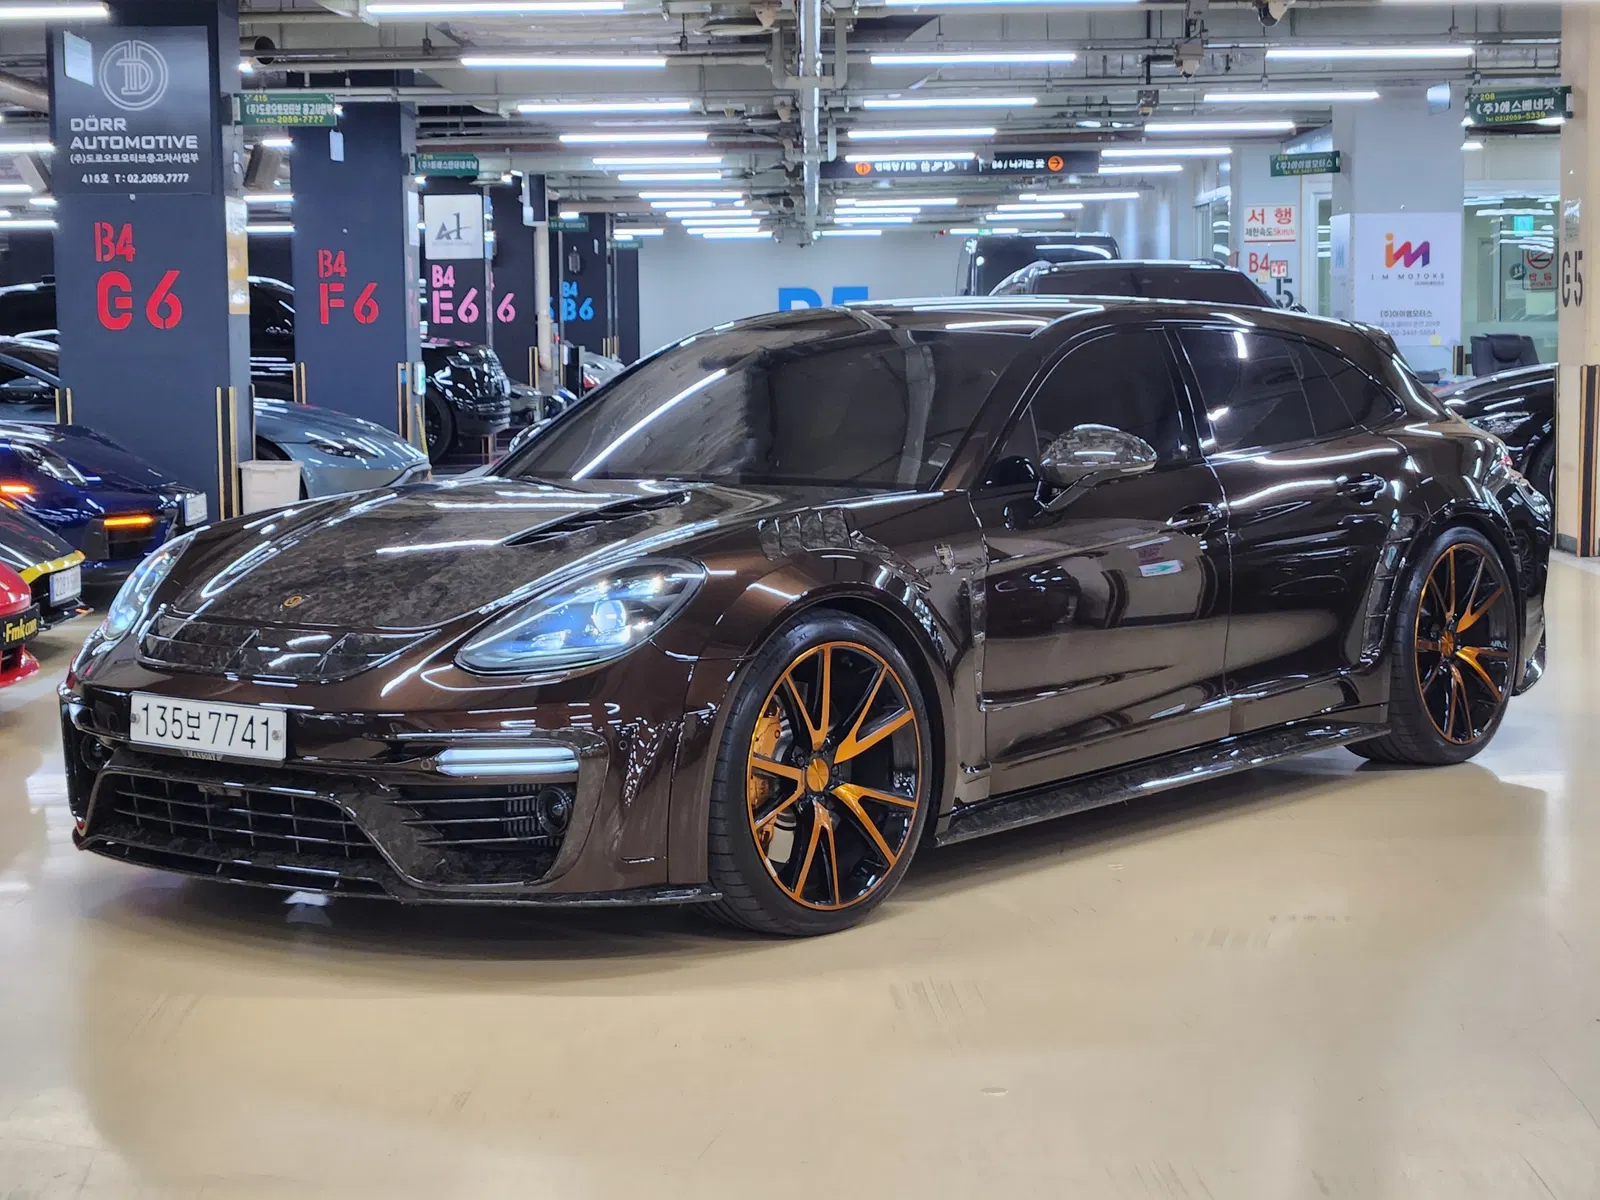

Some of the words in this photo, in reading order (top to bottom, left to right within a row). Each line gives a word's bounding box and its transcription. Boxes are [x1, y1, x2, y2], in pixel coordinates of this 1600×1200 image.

[253, 94, 268, 102] 415
[1480, 93, 1496, 101] 208
[1476, 97, 1555, 115] (주)에스베네핏
[70, 115, 127, 132] DÖRR
[70, 135, 199, 150] AUTOMOTIVE
[94, 222, 136, 262] B4
[318, 249, 347, 278] B4
[1249, 252, 1269, 273] B4
[432, 264, 455, 288] B4
[562, 281, 578, 298] B4
